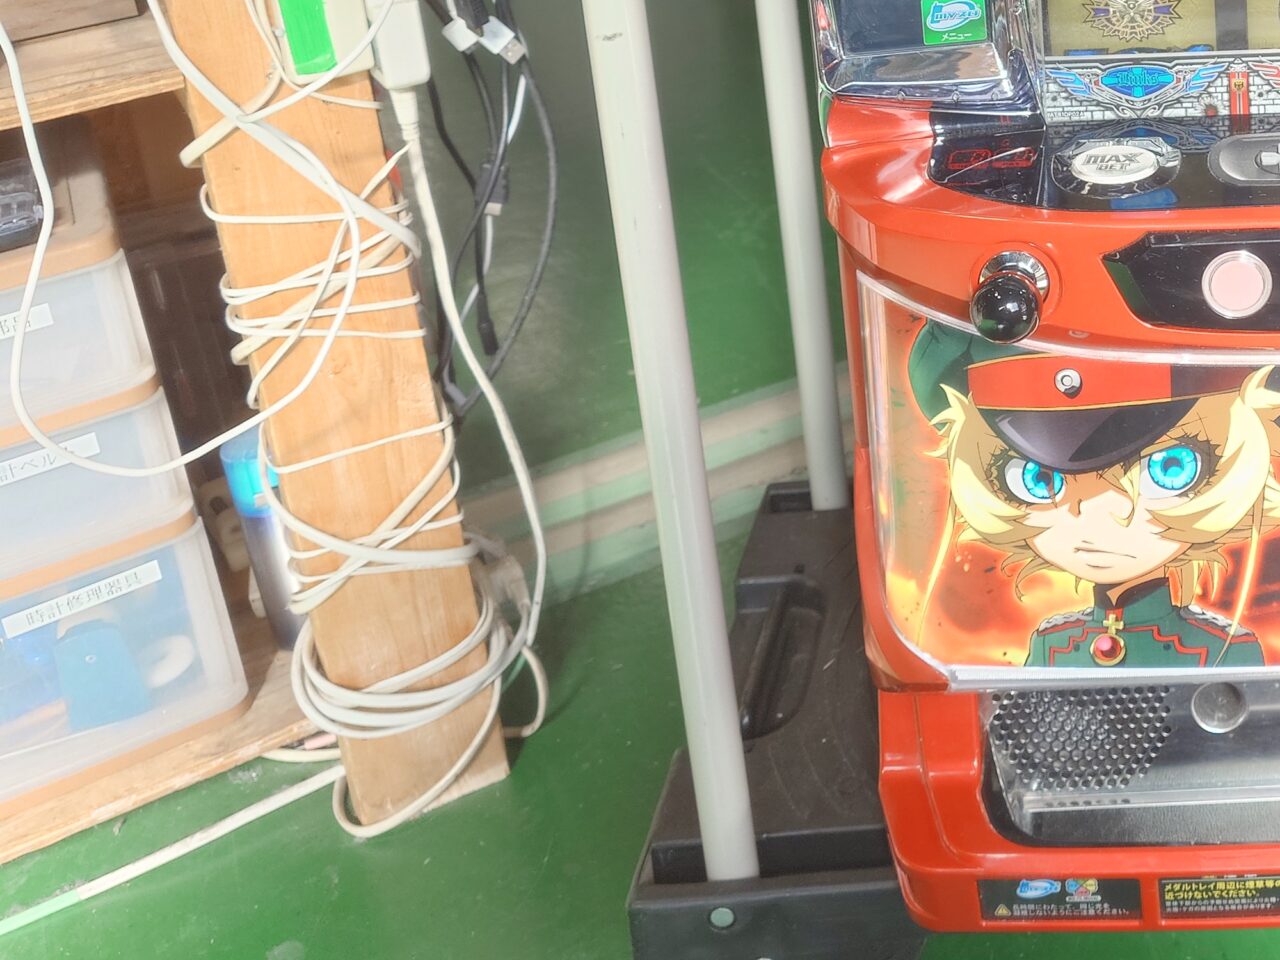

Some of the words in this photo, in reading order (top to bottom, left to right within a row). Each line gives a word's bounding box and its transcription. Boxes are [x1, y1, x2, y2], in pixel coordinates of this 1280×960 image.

[941, 32, 972, 41] メニュー
[1117, 70, 1158, 86] Links
[1082, 151, 1143, 166] MAX
[1095, 163, 1131, 172] BET
[1164, 890, 1261, 900] 近づけないでください。
